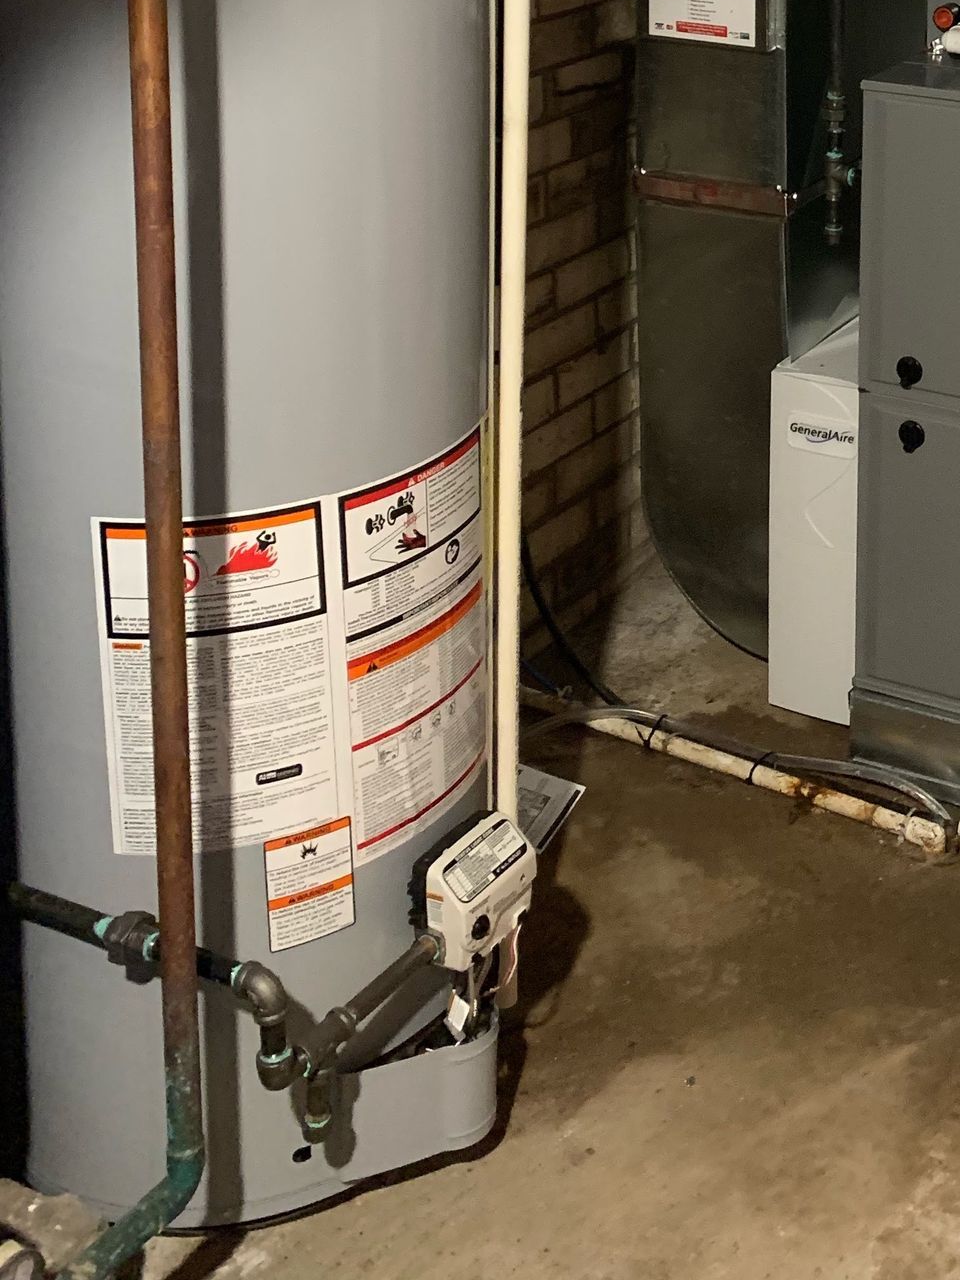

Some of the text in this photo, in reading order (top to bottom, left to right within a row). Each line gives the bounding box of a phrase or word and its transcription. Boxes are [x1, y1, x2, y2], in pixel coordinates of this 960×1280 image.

[790, 422, 855, 444] GeneralAire
[417, 461, 445, 482] DANGER
[293, 826, 332, 842] WARNING
[297, 884, 335, 901] WARNING
